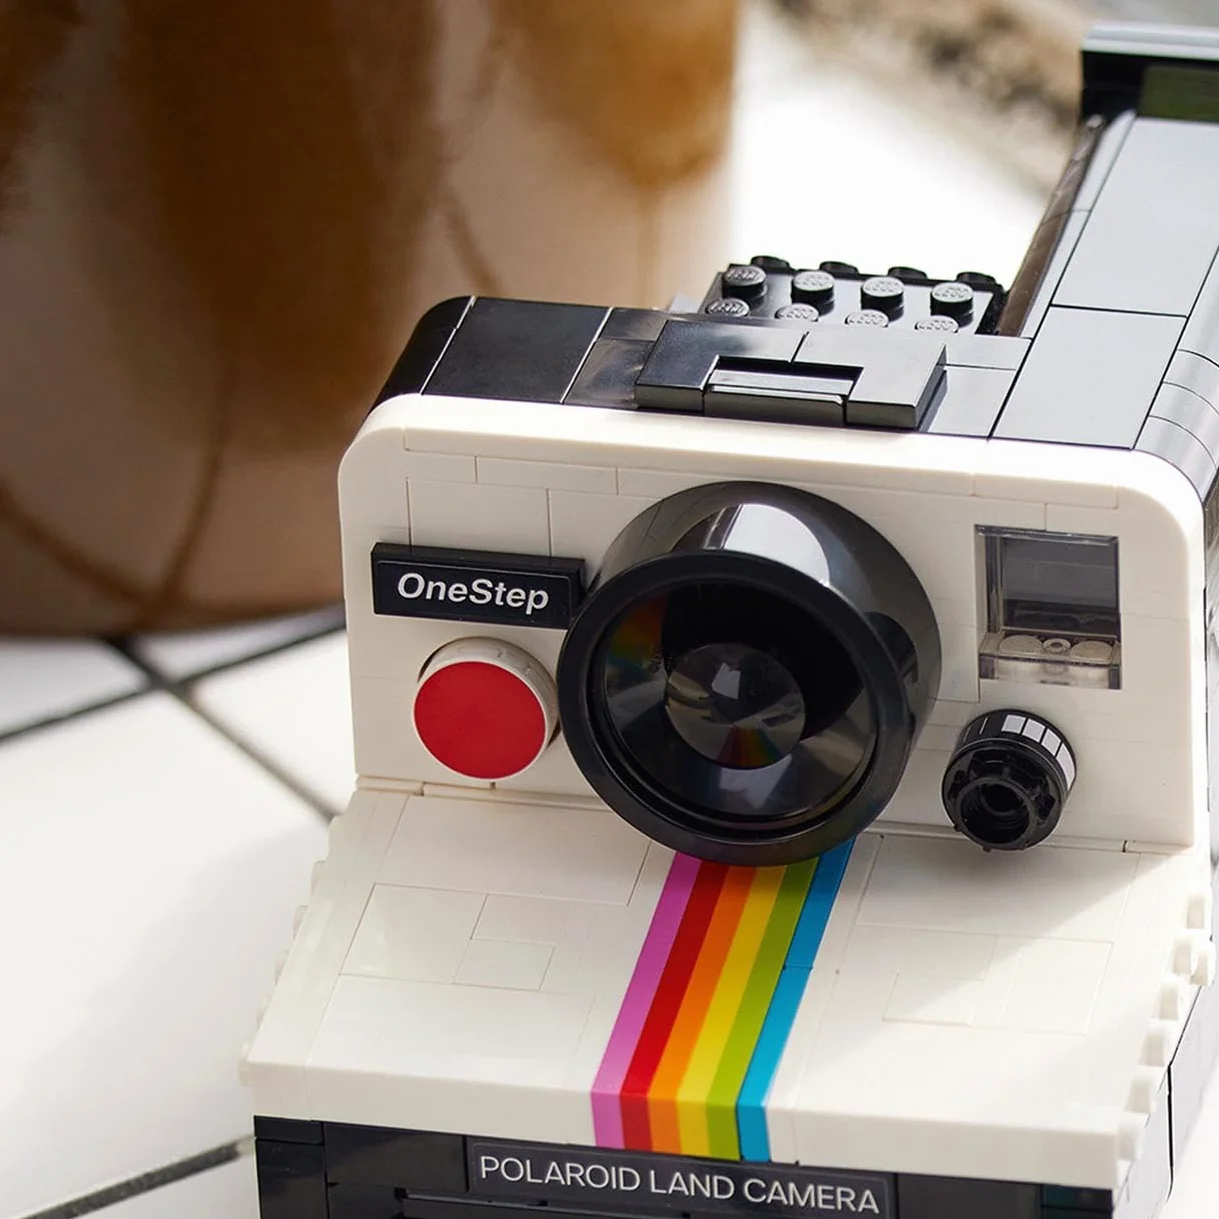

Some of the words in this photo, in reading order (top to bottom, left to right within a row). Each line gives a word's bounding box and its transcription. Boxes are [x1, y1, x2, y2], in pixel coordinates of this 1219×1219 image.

[397, 572, 549, 616] OneStep
[480, 1155, 641, 1191] POLAROID
[650, 1170, 735, 1201] LAND
[743, 1178, 880, 1215] CAMERA
